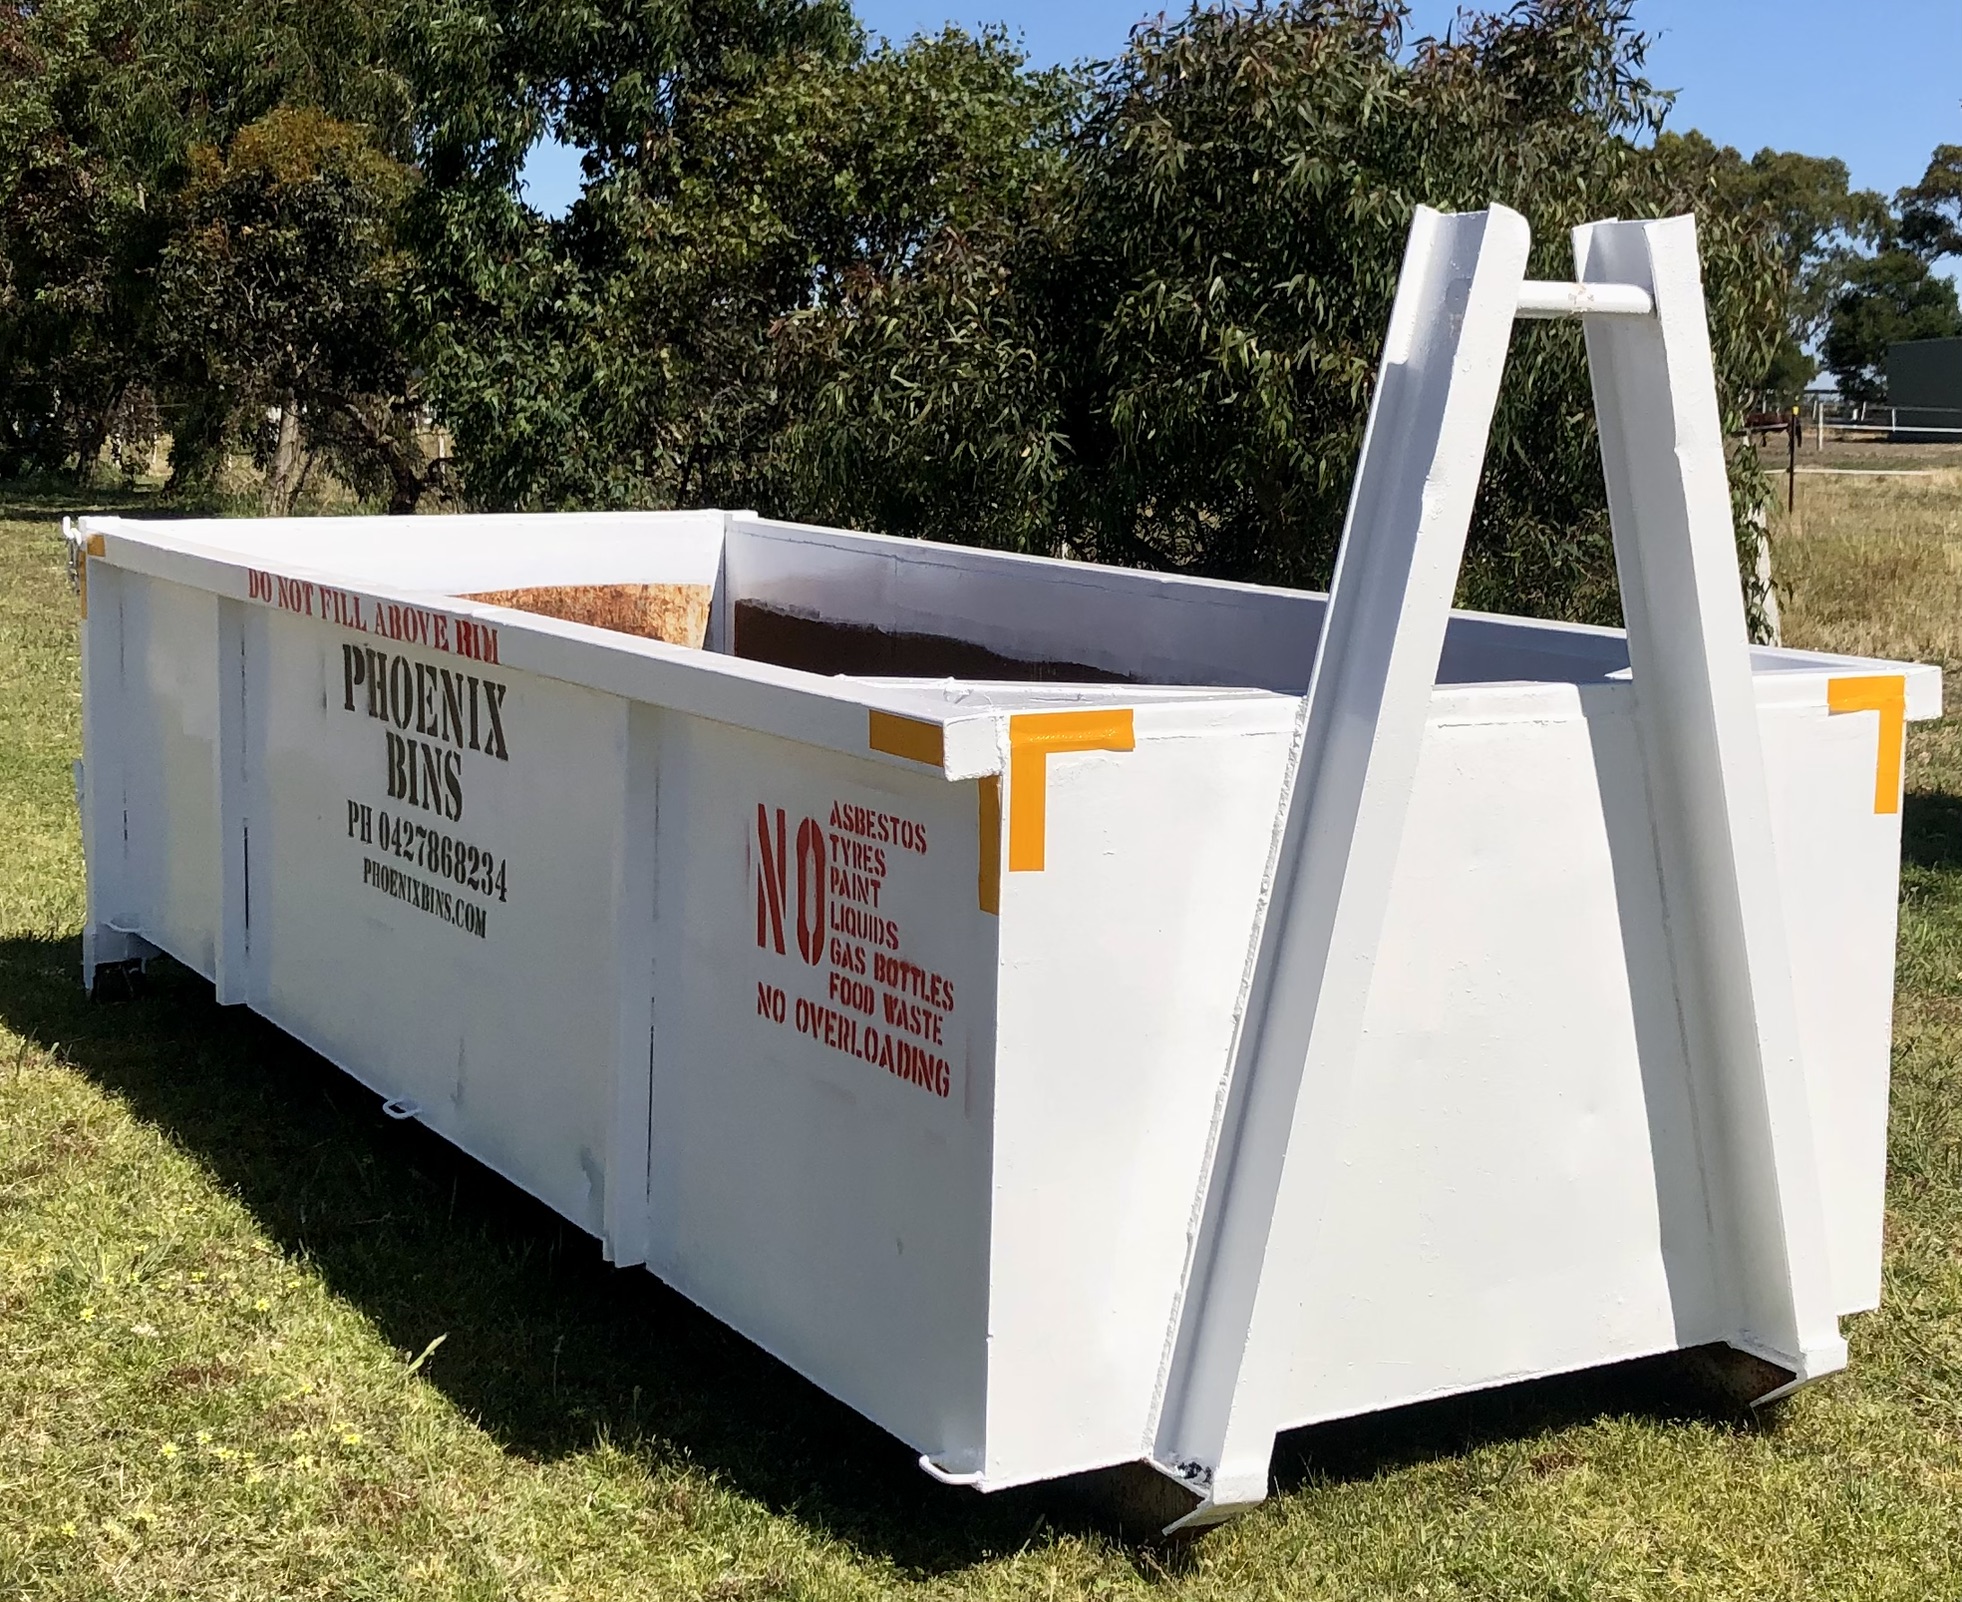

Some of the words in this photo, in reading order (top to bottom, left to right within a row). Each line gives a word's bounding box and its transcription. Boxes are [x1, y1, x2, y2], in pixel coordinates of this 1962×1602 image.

[248, 568, 273, 602] DO
[277, 575, 314, 616] NOT
[319, 585, 367, 631] FILL
[374, 602, 450, 651] ABOVE
[455, 619, 500, 665] RIM
[342, 643, 508, 761] PHOENIX
[385, 729, 463, 822] BINS
[347, 799, 372, 844] PH
[379, 811, 508, 902] 0427868234
[829, 800, 927, 855] ASBESTOS
[829, 832, 886, 878] TYRES
[363, 857, 487, 938] PHOENIXBINS.COM
[757, 803, 825, 966] NO
[830, 866, 881, 908] PAINT
[830, 901, 899, 950] LIQUIDS
[829, 971, 874, 1016] FOOD
[883, 992, 944, 1046] WASTE
[830, 937, 866, 975] GAS
[874, 952, 954, 1012] BOTTLES
[757, 981, 786, 1024] NO
[795, 998, 950, 1098] OVERLOADING
